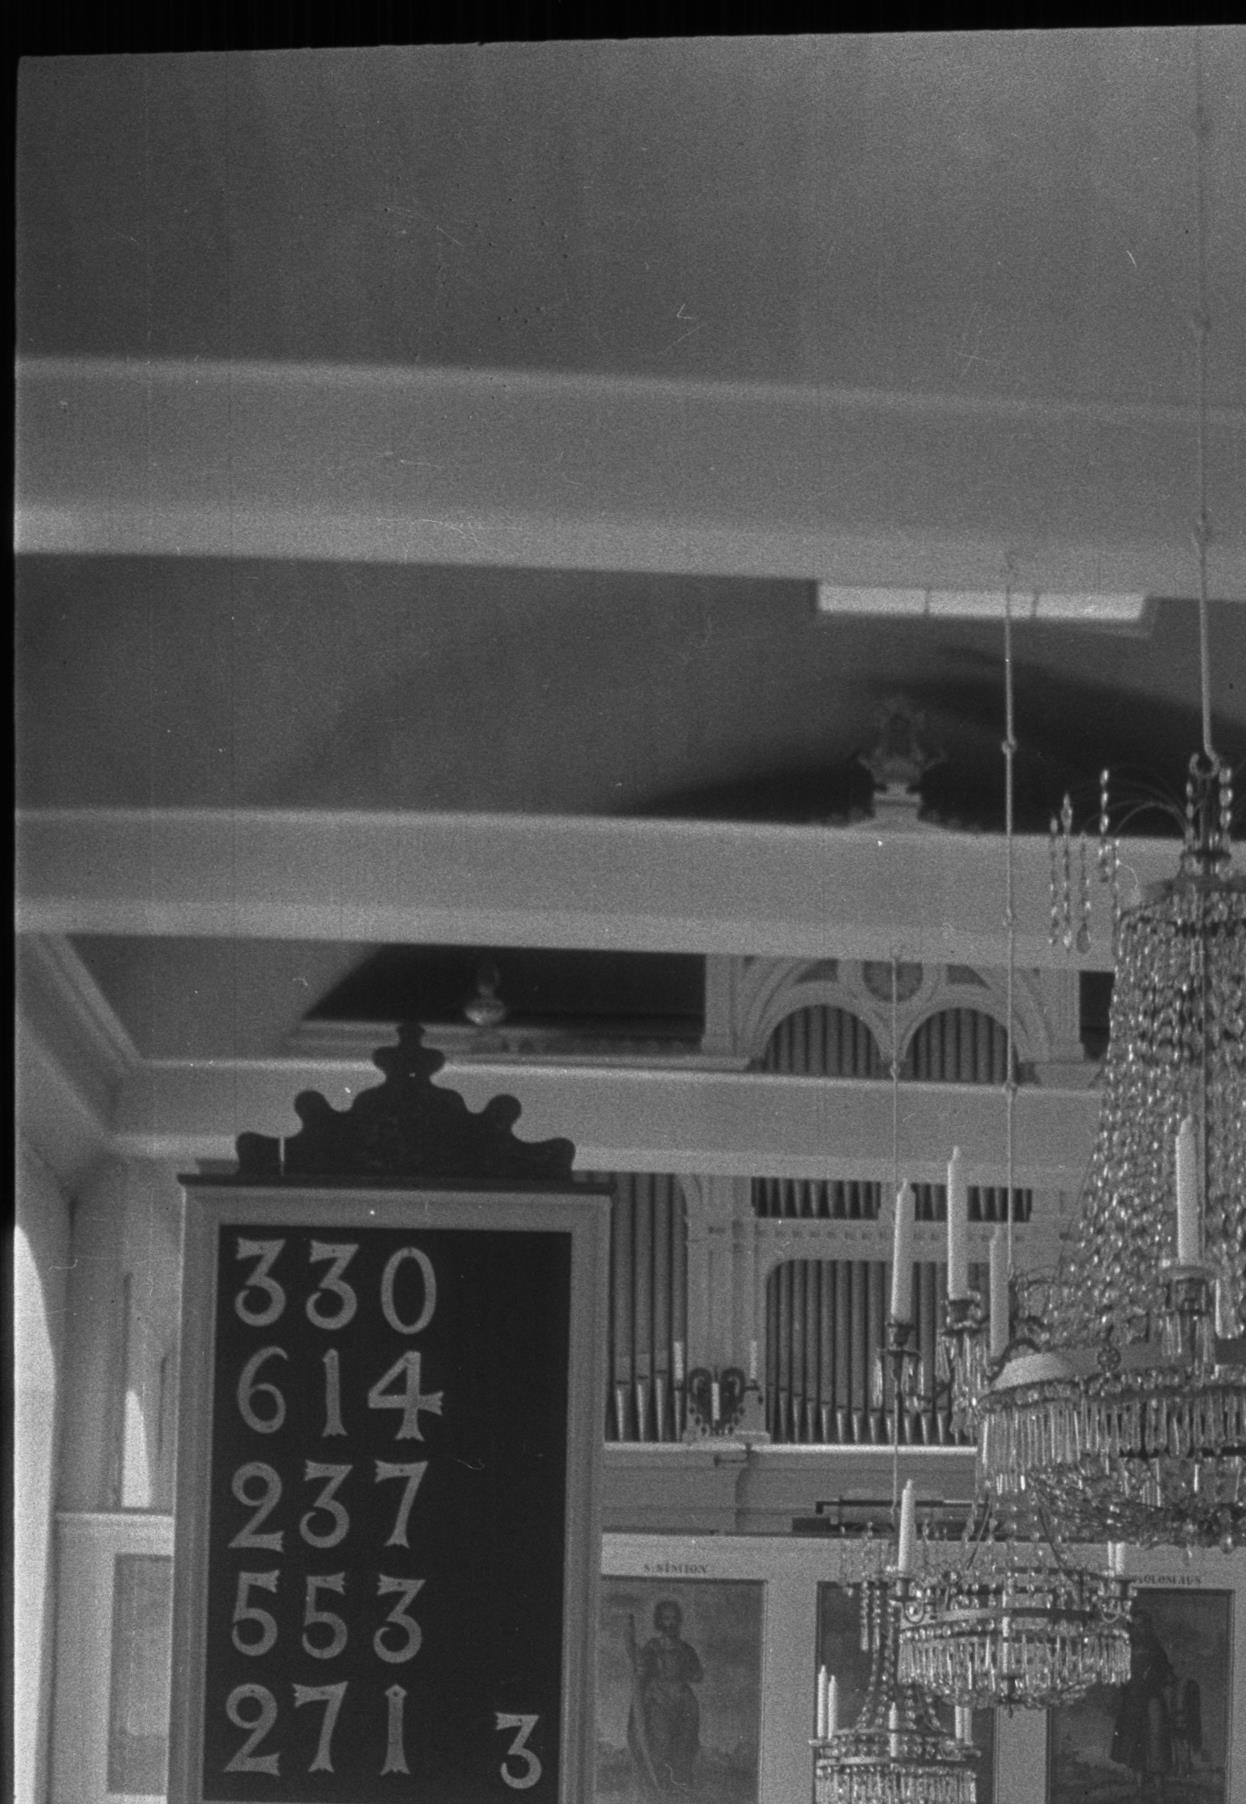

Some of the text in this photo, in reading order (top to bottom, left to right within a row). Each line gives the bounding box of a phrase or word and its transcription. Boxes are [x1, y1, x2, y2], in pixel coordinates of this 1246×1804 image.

[235, 1237, 436, 1334] 330
[237, 1346, 444, 1441] 614
[228, 1460, 428, 1552] 237
[232, 1569, 425, 1663] 553
[223, 1681, 542, 1789] 271 3
